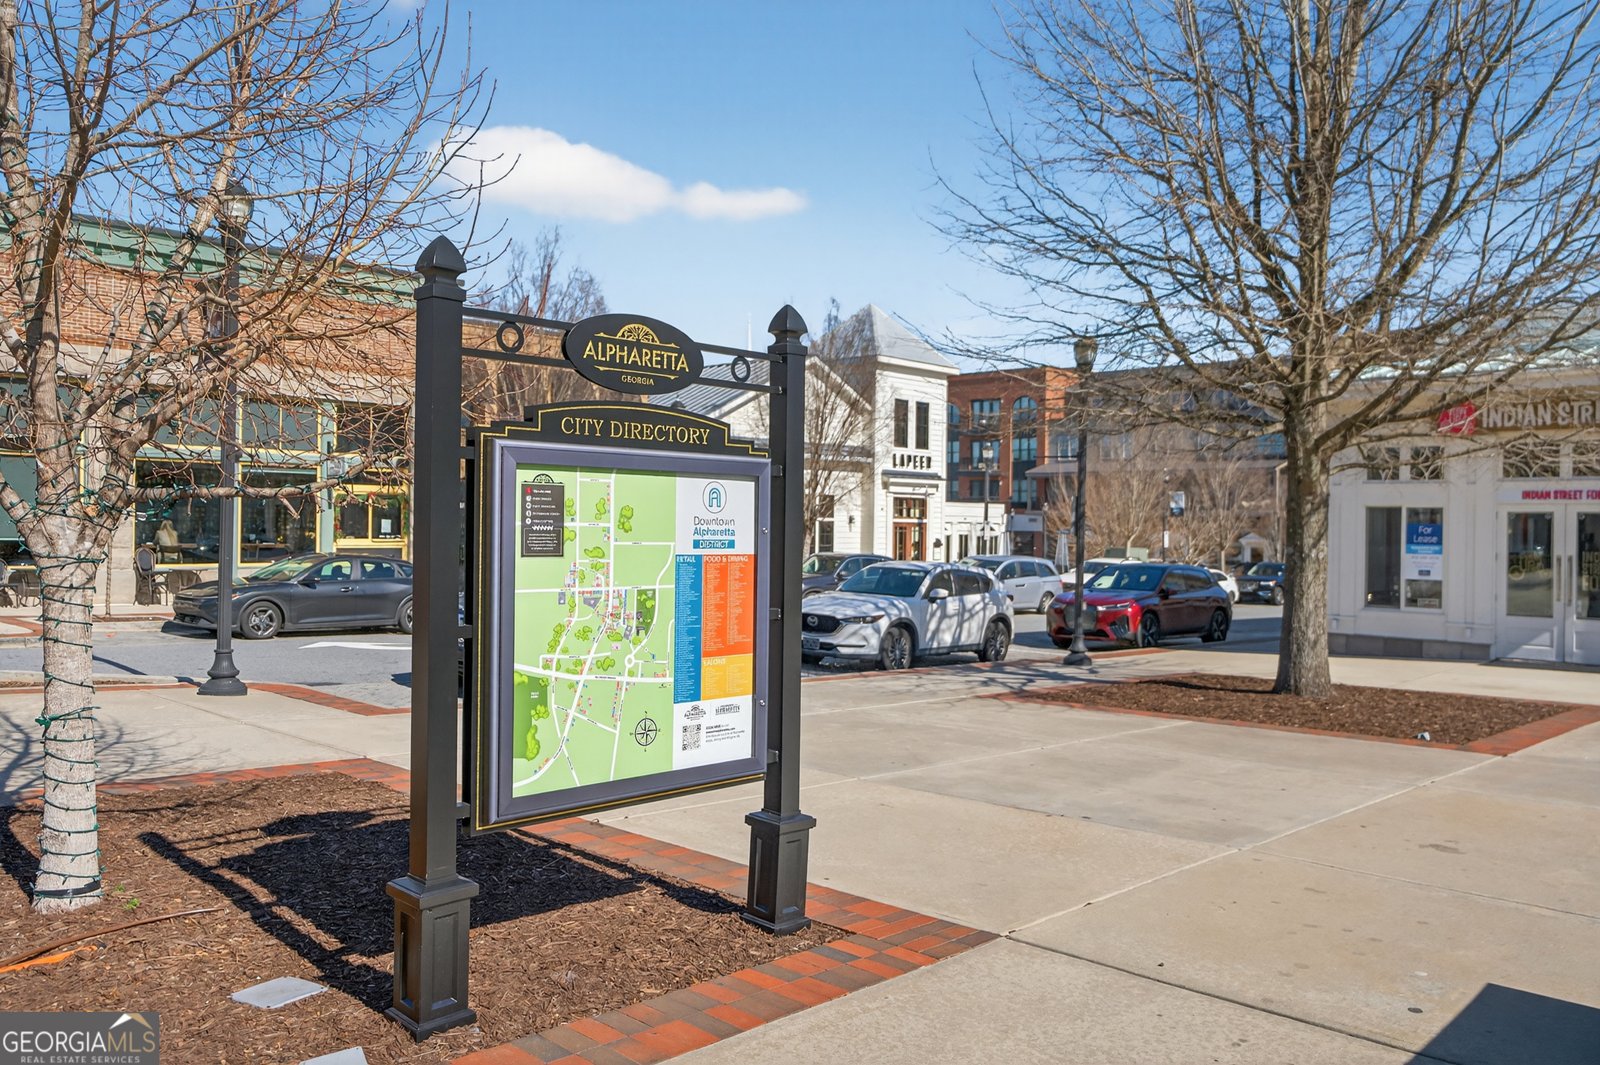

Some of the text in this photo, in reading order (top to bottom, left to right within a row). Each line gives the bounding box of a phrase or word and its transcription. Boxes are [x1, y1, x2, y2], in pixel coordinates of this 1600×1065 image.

[583, 340, 689, 372] ALPHARETTA
[621, 375, 654, 386] GEORGIA
[1481, 402, 1552, 428] INDIAN
[561, 416, 710, 445] CITY DIRECTORY
[892, 453, 932, 470] LAPEER
[1521, 489, 1551, 500] INDIAN
[1553, 489, 1583, 500] STREET
[693, 515, 735, 527] Downtown
[693, 526, 736, 538] Alpharetta
[1418, 525, 1433, 535] For
[699, 540, 729, 549] DISTRICT
[1413, 534, 1439, 544] Lease
[676, 555, 696, 563] RETAIL
[703, 555, 721, 563] FOOD
[728, 555, 749, 563] DINING
